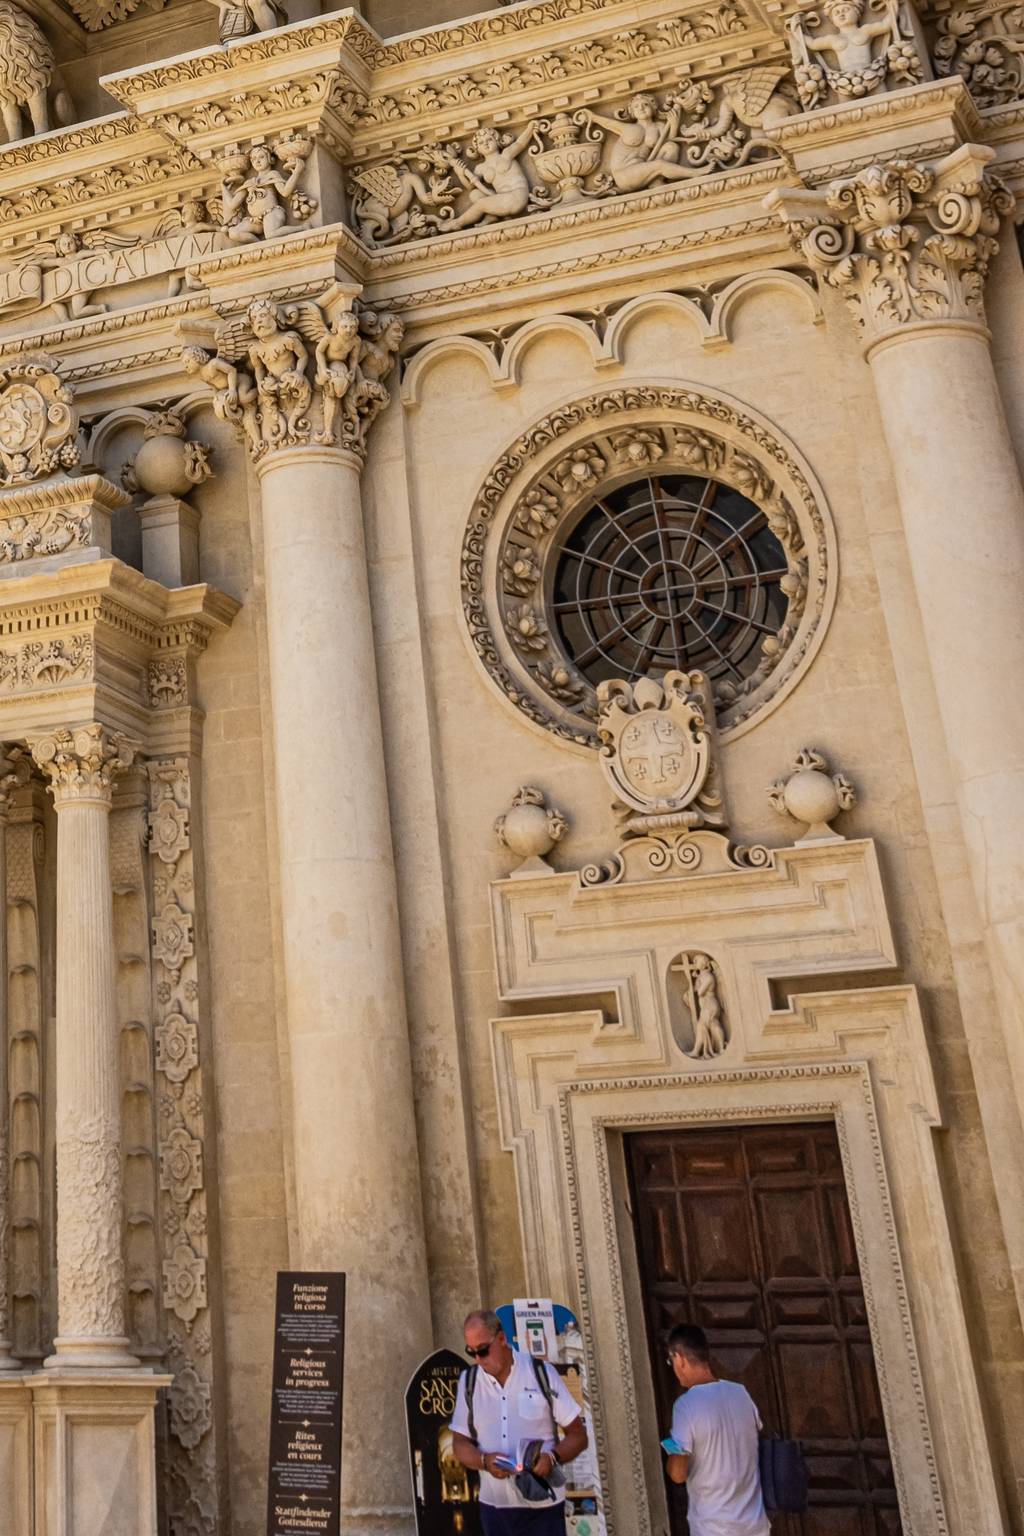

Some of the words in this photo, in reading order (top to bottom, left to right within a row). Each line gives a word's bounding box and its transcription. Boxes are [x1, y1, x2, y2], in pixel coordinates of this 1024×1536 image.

[52, 231, 217, 300] DICATVM
[292, 1283, 329, 1293] Funzione
[293, 1293, 327, 1303] religiosa
[293, 1302, 303, 1311] in
[304, 1303, 326, 1311] corso
[290, 1358, 327, 1369] Religious
[292, 1368, 324, 1377] services
[285, 1376, 295, 1386] in
[295, 1378, 330, 1388] progress
[295, 1430, 316, 1441] Rites
[287, 1440, 323, 1451] religieux
[287, 1452, 298, 1460] en
[299, 1451, 323, 1461] cours
[274, 1505, 333, 1519] Stattfindender
[278, 1515, 328, 1529] Gottesdienst
